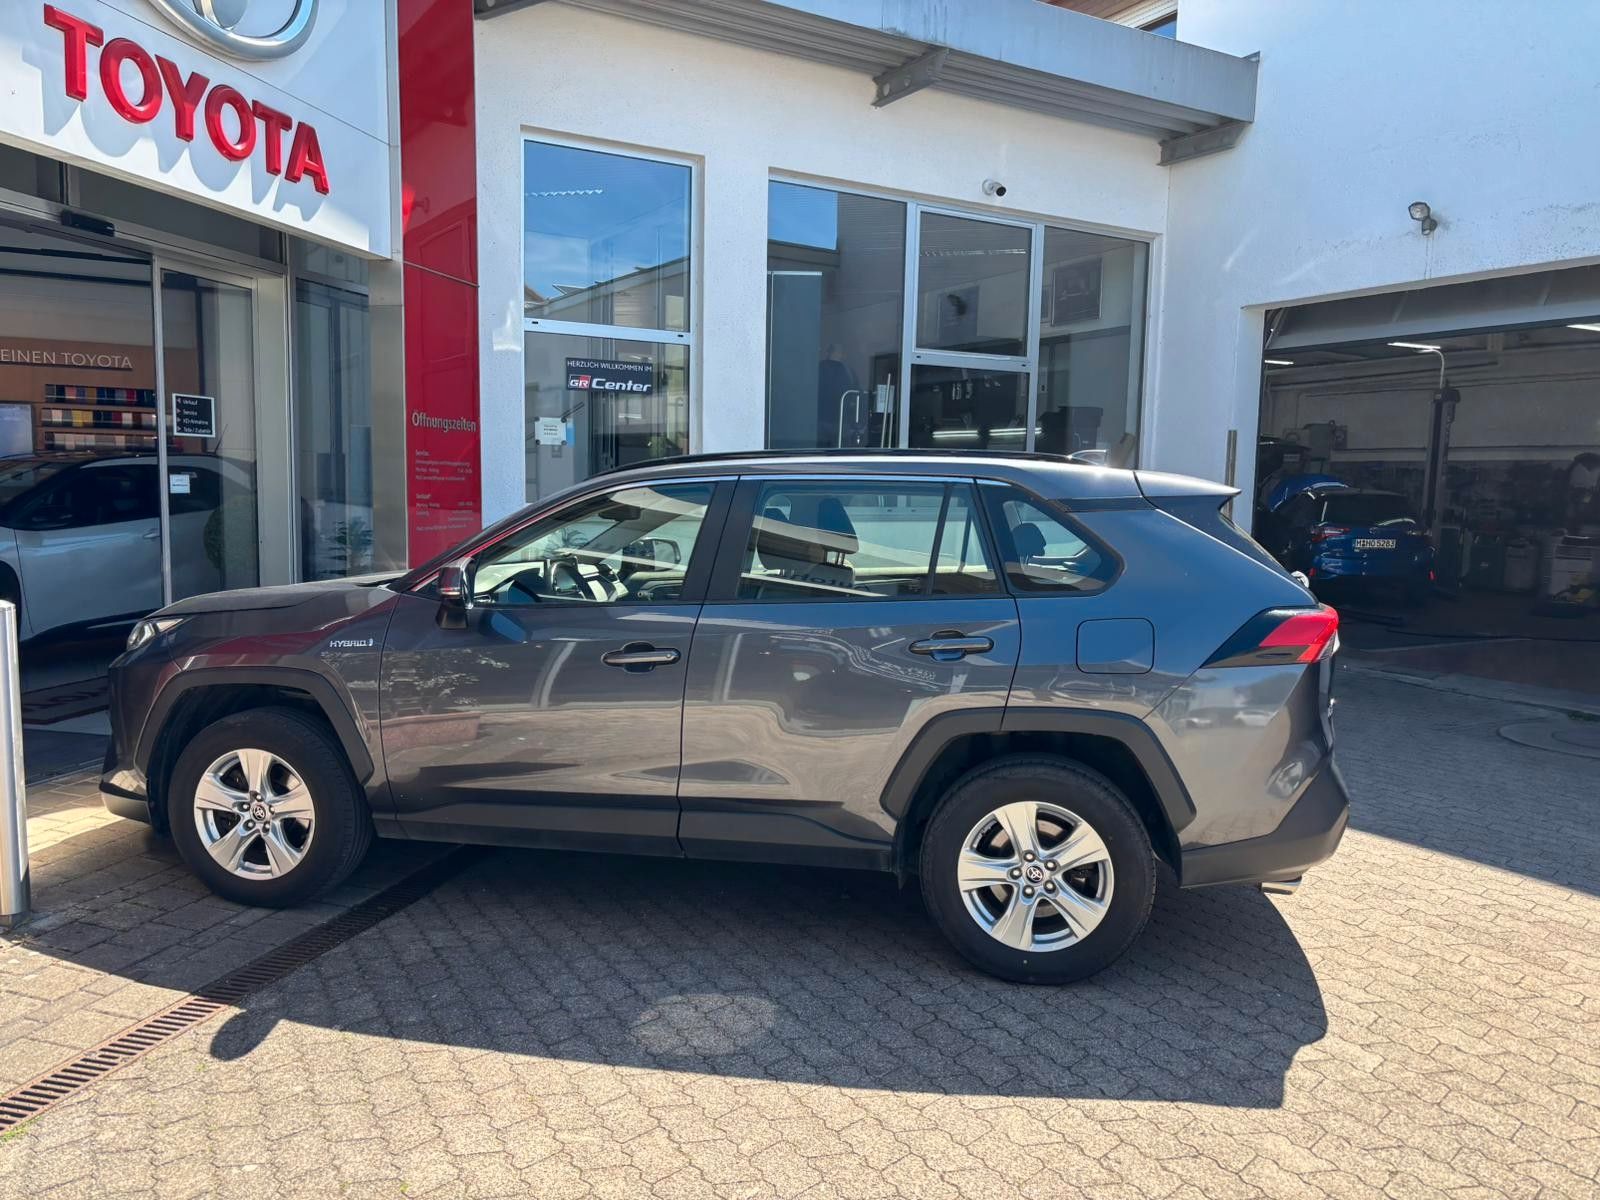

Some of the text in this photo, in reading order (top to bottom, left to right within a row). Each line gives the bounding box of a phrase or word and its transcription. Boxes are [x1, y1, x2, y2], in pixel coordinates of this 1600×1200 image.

[43, 3, 331, 195] TOYOTA
[60, 352, 133, 369] TOYOTA
[567, 360, 599, 368] HERZLICH
[600, 362, 643, 372] WILLKOMMEN
[569, 377, 652, 392] GR Center
[411, 411, 477, 433] Öffnungszeiten
[329, 639, 367, 648] HYBRID
